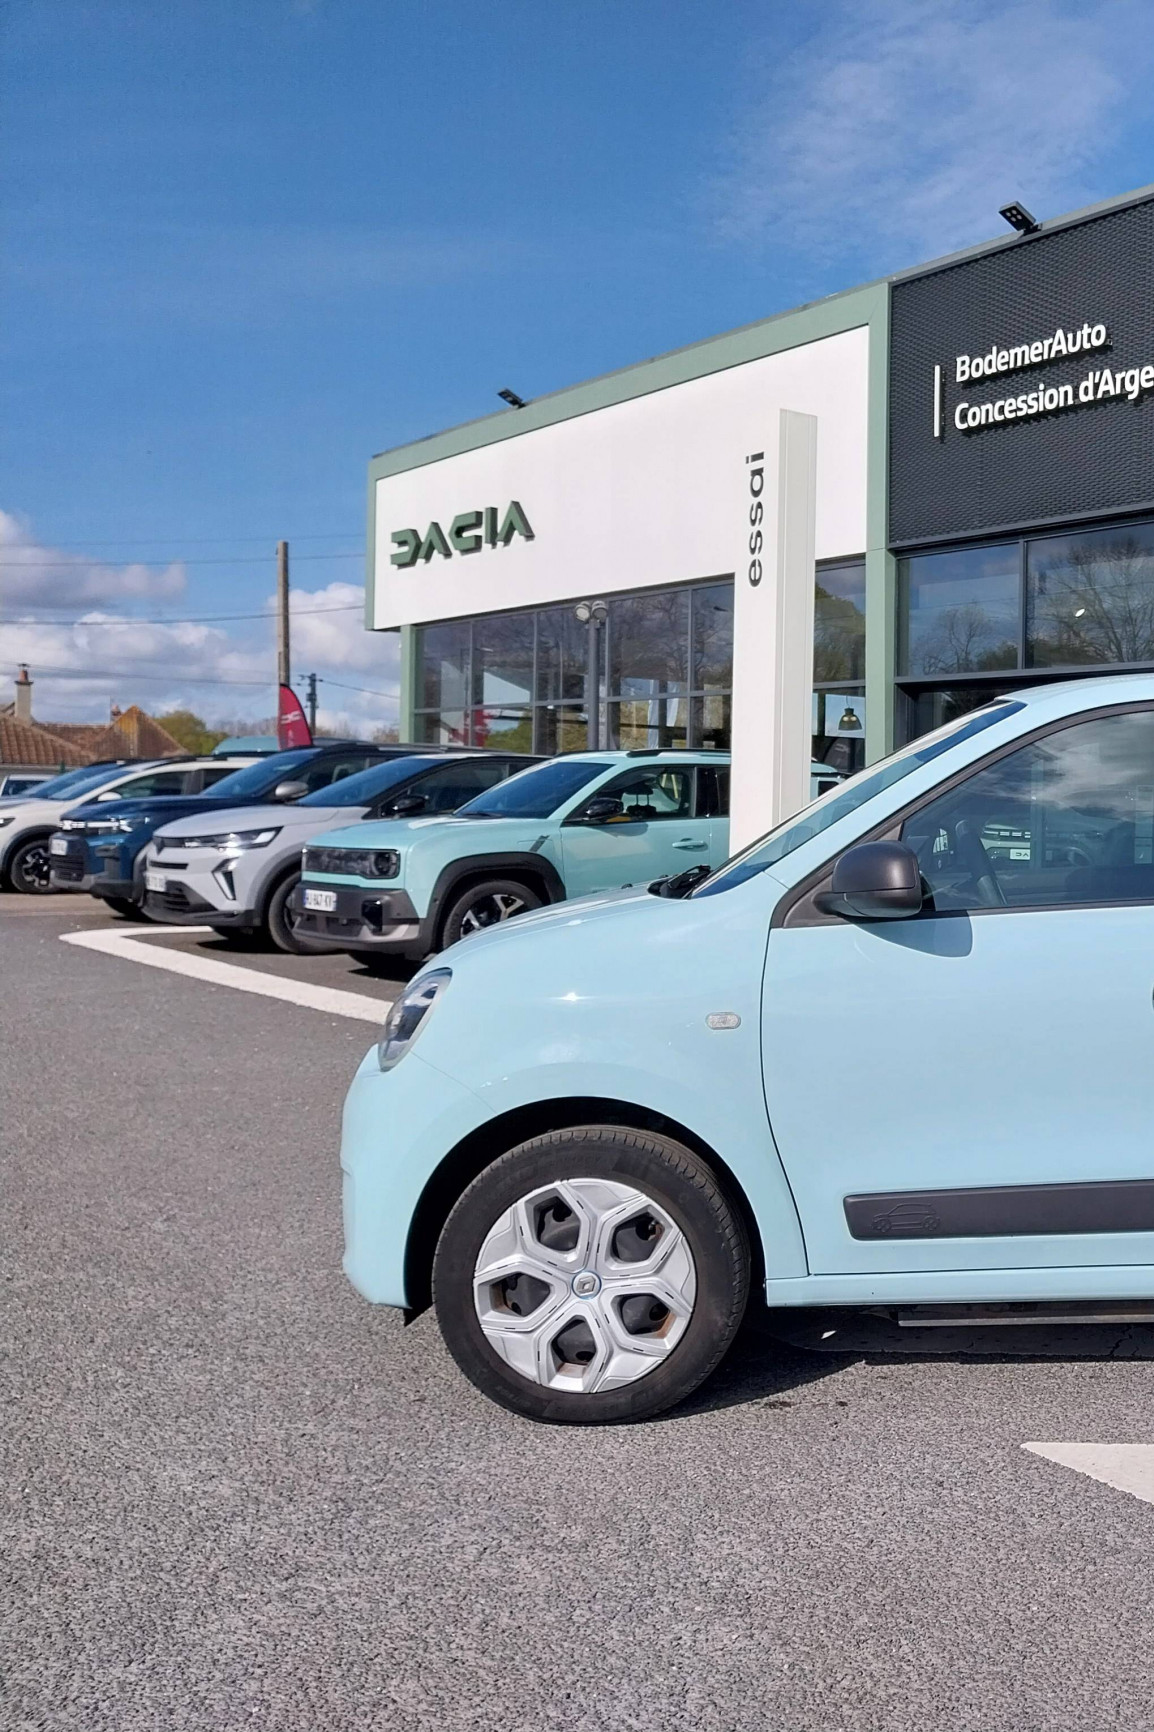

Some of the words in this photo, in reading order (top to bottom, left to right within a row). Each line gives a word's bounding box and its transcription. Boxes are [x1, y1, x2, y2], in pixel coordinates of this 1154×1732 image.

[955, 323, 1107, 382] BodemerAuto
[954, 383, 1074, 430] Concession
[390, 500, 535, 570] DACIA
[745, 451, 764, 588] essai
